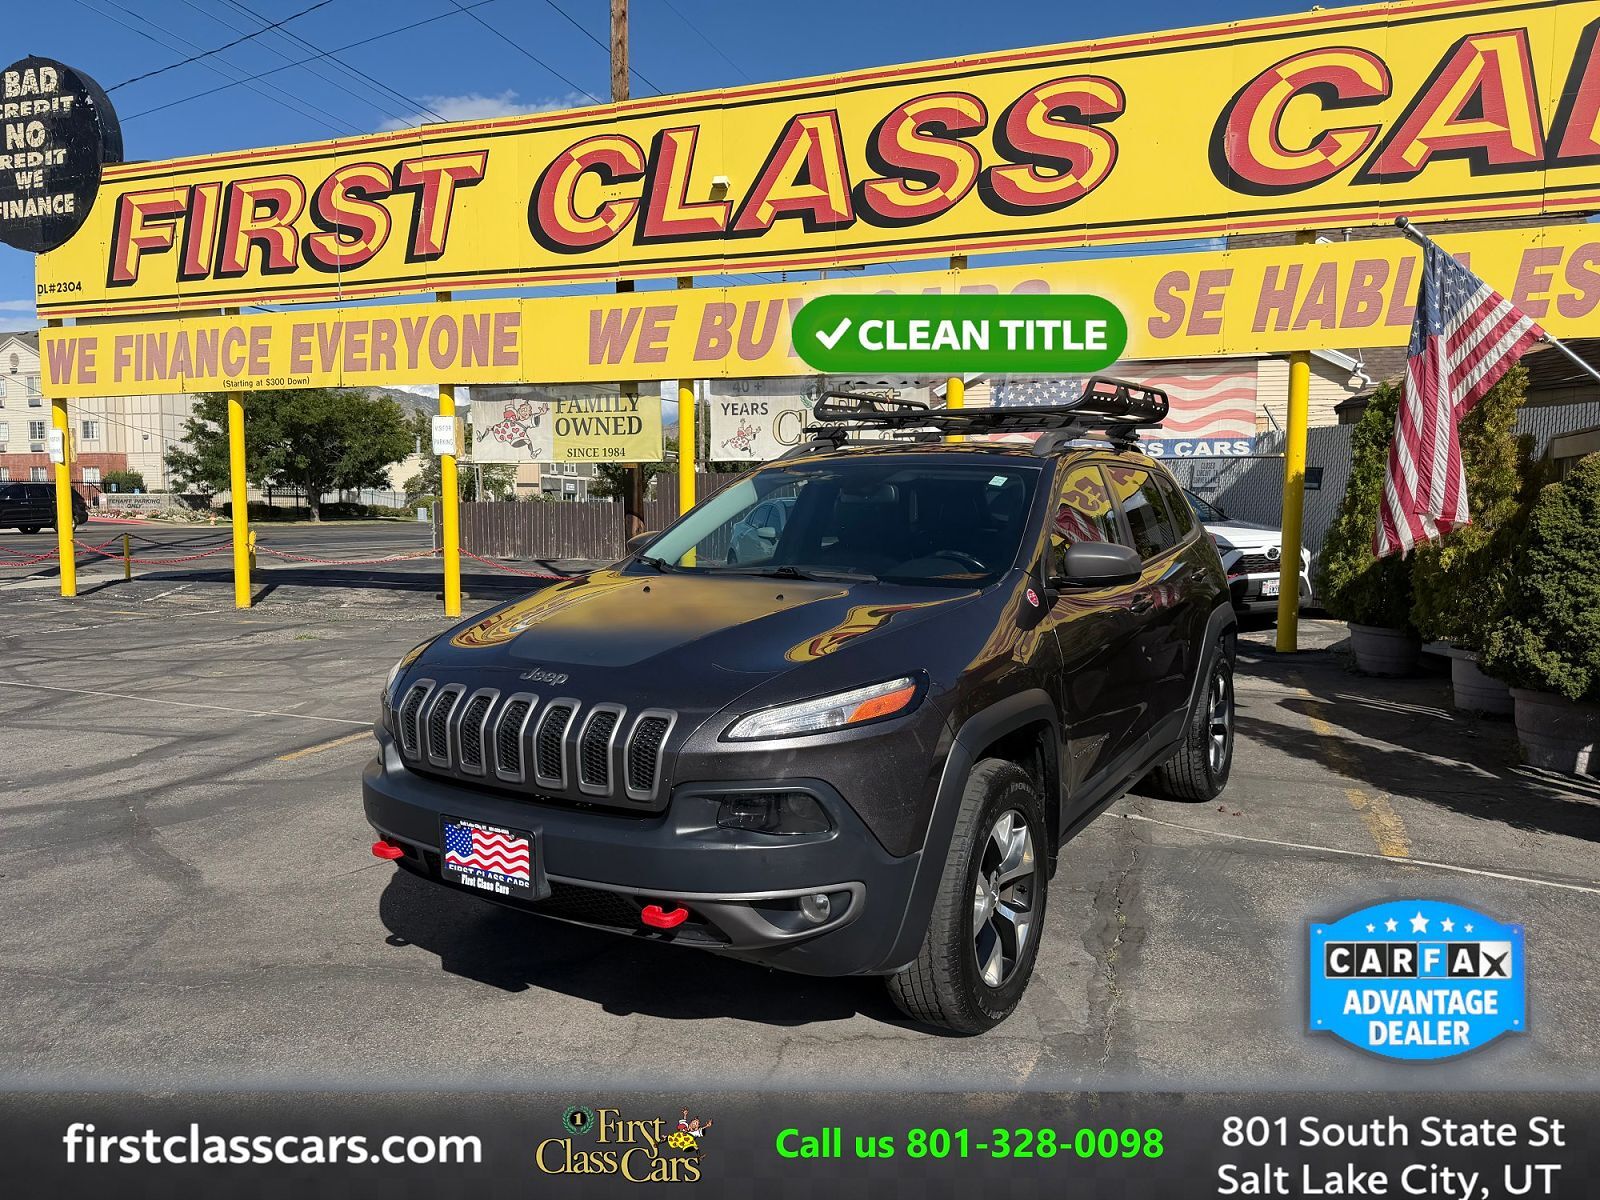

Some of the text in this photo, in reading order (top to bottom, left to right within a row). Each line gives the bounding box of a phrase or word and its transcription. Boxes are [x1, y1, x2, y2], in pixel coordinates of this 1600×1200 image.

[4, 66, 58, 99] BAD
[6, 120, 46, 150] NO
[16, 170, 44, 190] WE
[106, 150, 489, 288] FIRST
[527, 74, 1127, 255] CLASS
[0, 193, 75, 220] INANCE
[37, 281, 82, 294] DL#2304
[1147, 268, 1234, 339] SE
[1251, 252, 1471, 333] HABL
[588, 305, 678, 365] WE
[46, 312, 522, 385] WE FINANCE EVERYONE
[222, 376, 310, 388] (Starting at $300 Down)
[732, 381, 750, 393] 40
[555, 392, 640, 414] FAMILY
[720, 402, 769, 416] YEARS
[555, 415, 643, 437] OWNED
[566, 447, 626, 458] SINCE 1984
[1174, 441, 1250, 456] CARS
[520, 667, 569, 687] Jeep
[461, 873, 510, 895] First Class Cars
